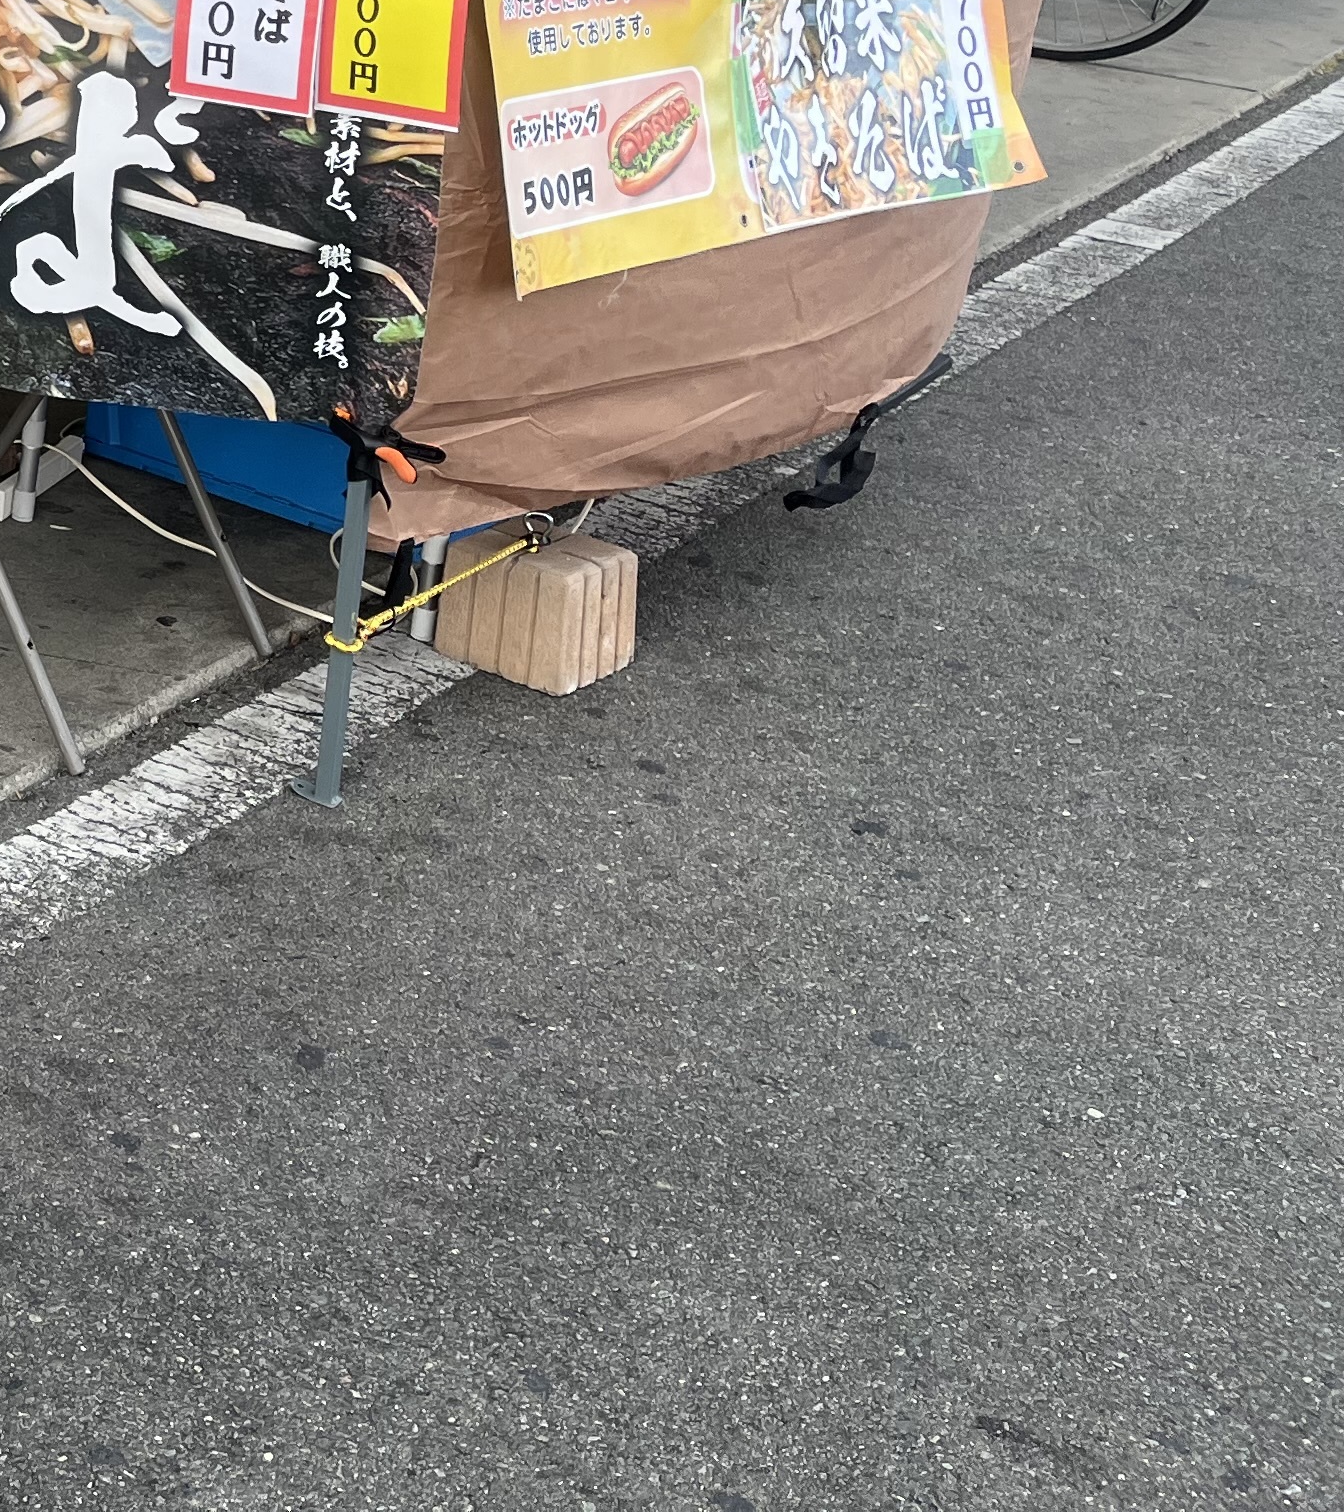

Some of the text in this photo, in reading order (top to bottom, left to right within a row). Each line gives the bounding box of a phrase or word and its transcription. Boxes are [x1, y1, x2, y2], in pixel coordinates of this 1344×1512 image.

[528, 13, 650, 56] 使用しております。
[513, 103, 599, 148] ホットドッグ
[764, 76, 958, 210] やきそば
[523, 166, 595, 216] 500円
